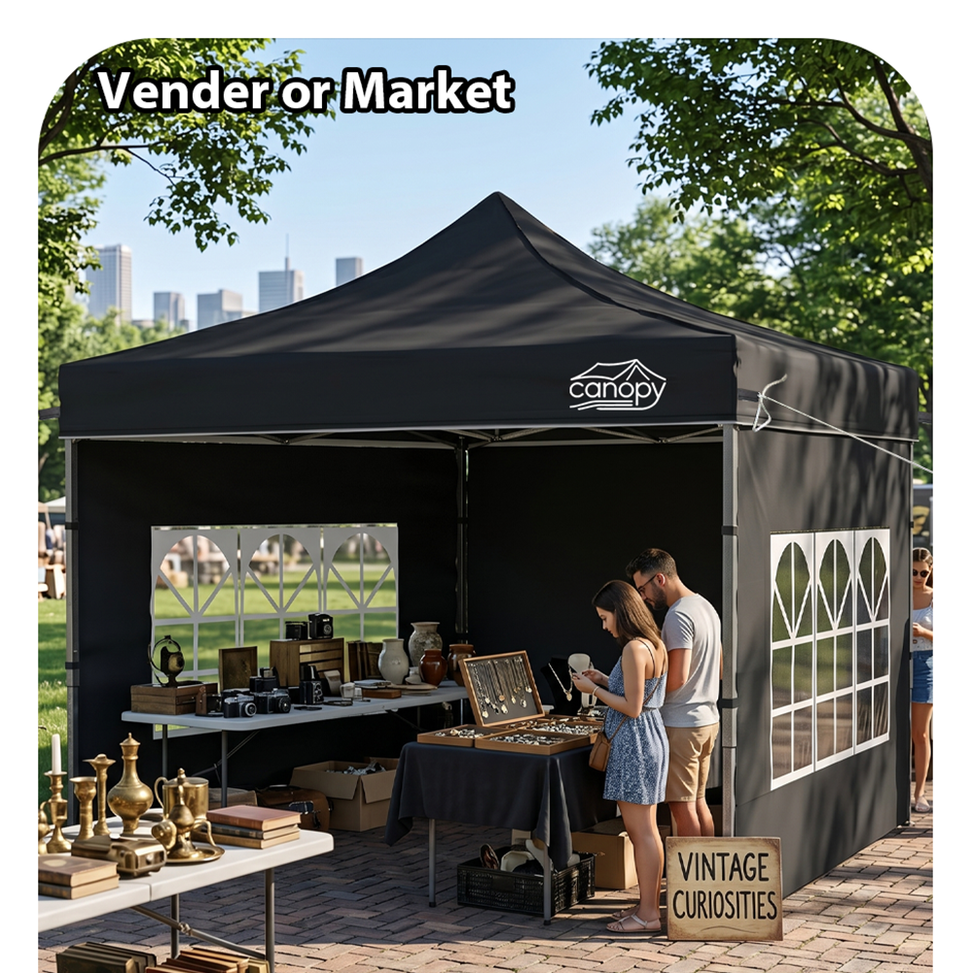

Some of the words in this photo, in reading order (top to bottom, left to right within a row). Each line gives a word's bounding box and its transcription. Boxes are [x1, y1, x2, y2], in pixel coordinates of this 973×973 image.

[569, 381, 667, 411] canopy
[678, 852, 769, 881] VINTAGE
[673, 889, 777, 920] CURIOSITIES
